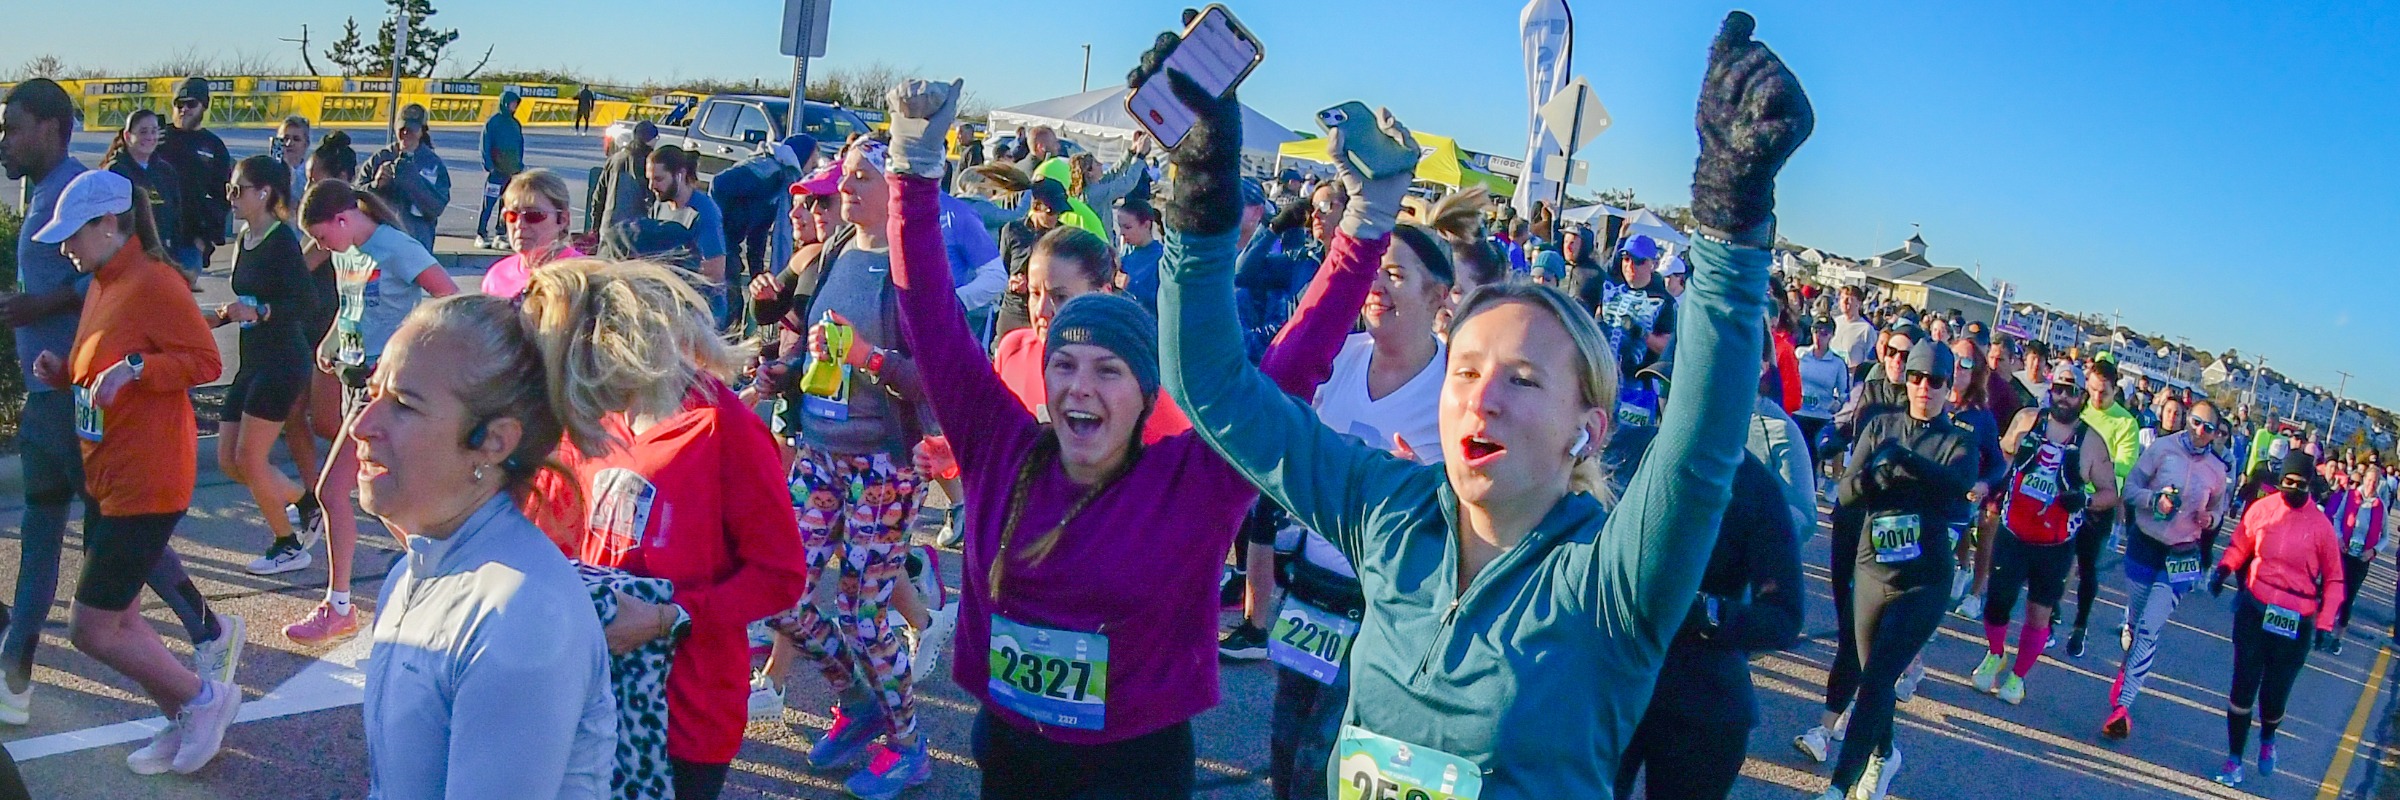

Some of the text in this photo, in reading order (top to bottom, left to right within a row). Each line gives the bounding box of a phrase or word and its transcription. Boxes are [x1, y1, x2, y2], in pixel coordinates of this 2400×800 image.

[106, 82, 147, 93] RHODE
[279, 81, 318, 91] RHODE
[444, 83, 480, 94] RHODE
[522, 86, 557, 97] RHODE
[2024, 474, 2055, 496] 2300
[1878, 528, 1915, 549] 2014
[2267, 611, 2297, 632] 2038
[1281, 616, 1342, 662] 2210
[1001, 646, 1091, 702] 2327
[1058, 714, 1078, 725] 2327
